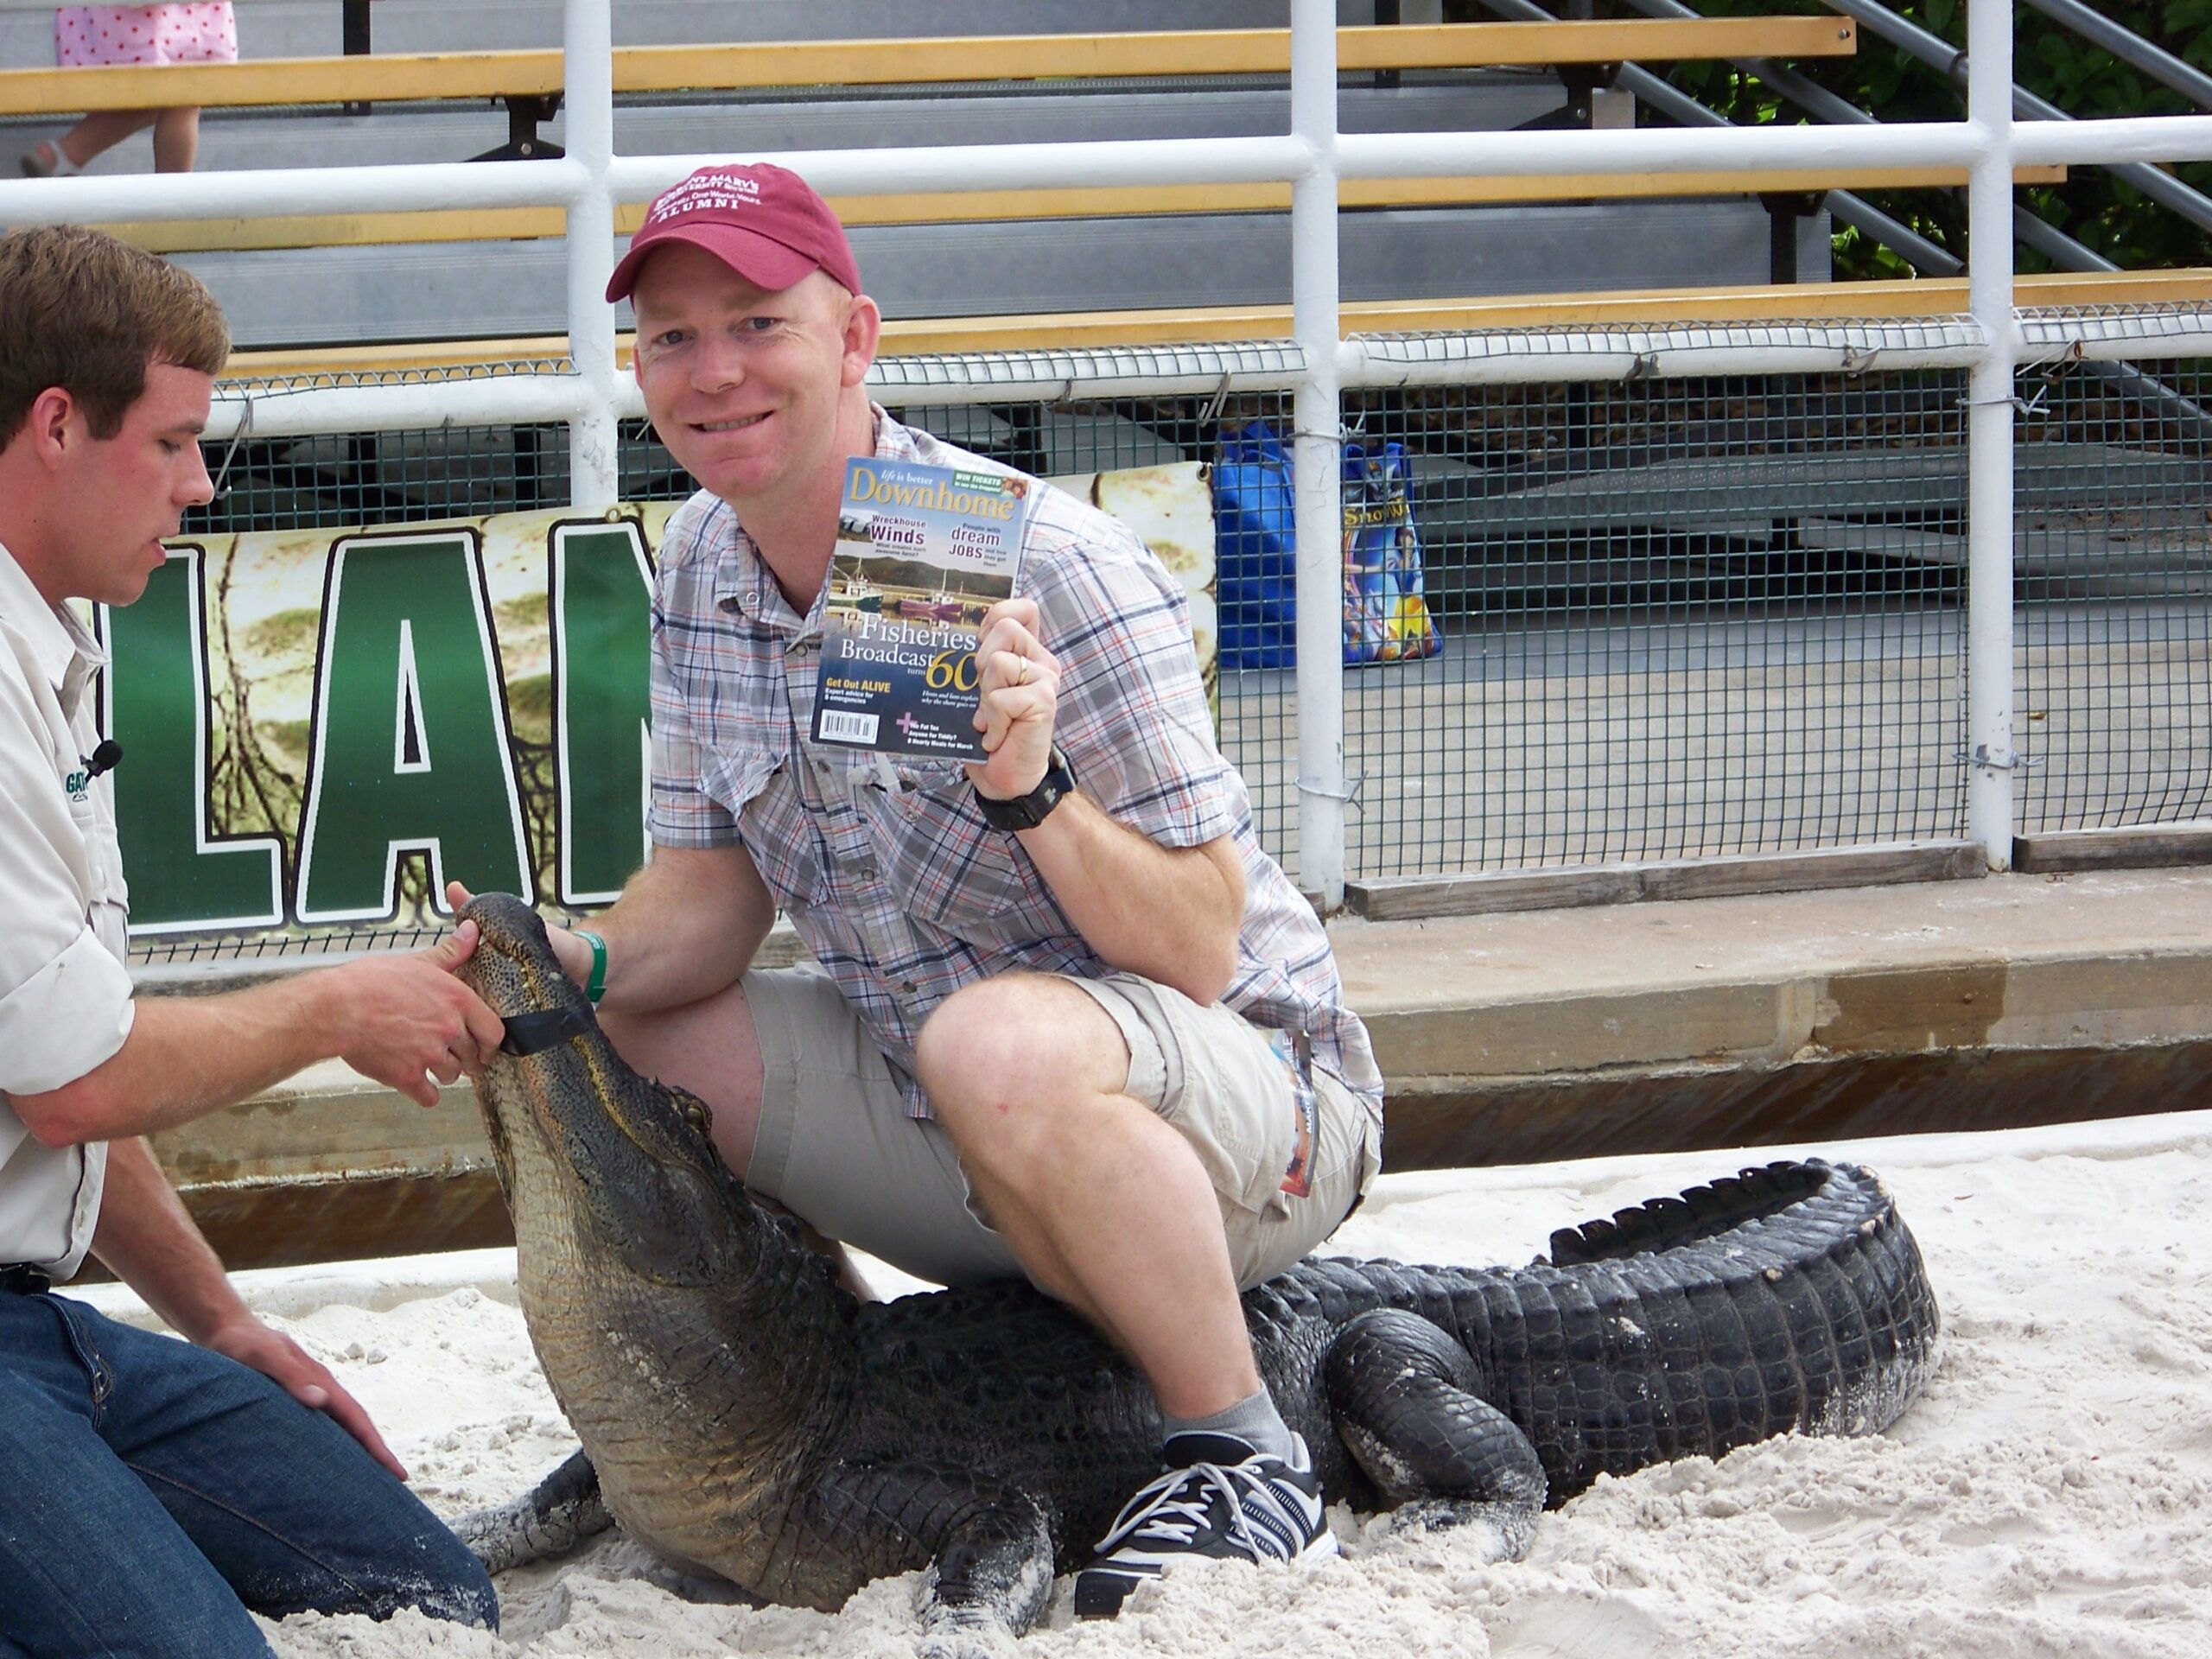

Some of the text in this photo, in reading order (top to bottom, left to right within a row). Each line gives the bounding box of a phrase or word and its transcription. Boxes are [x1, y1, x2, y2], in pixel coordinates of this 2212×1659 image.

[658, 199, 739, 223] ALUMNI
[881, 469, 933, 485] life is better
[956, 472, 1001, 486] WIN TICKETS
[850, 467, 1015, 521] Downhome
[872, 514, 926, 528] Wreckhouse
[871, 524, 925, 545] Winds
[951, 527, 1001, 546] dream
[949, 543, 983, 559] JOBS
[858, 612, 976, 652] Fisheries
[841, 639, 936, 668] Broadcast
[926, 650, 979, 691] 60
[826, 677, 891, 693] Get Out ALIVE
